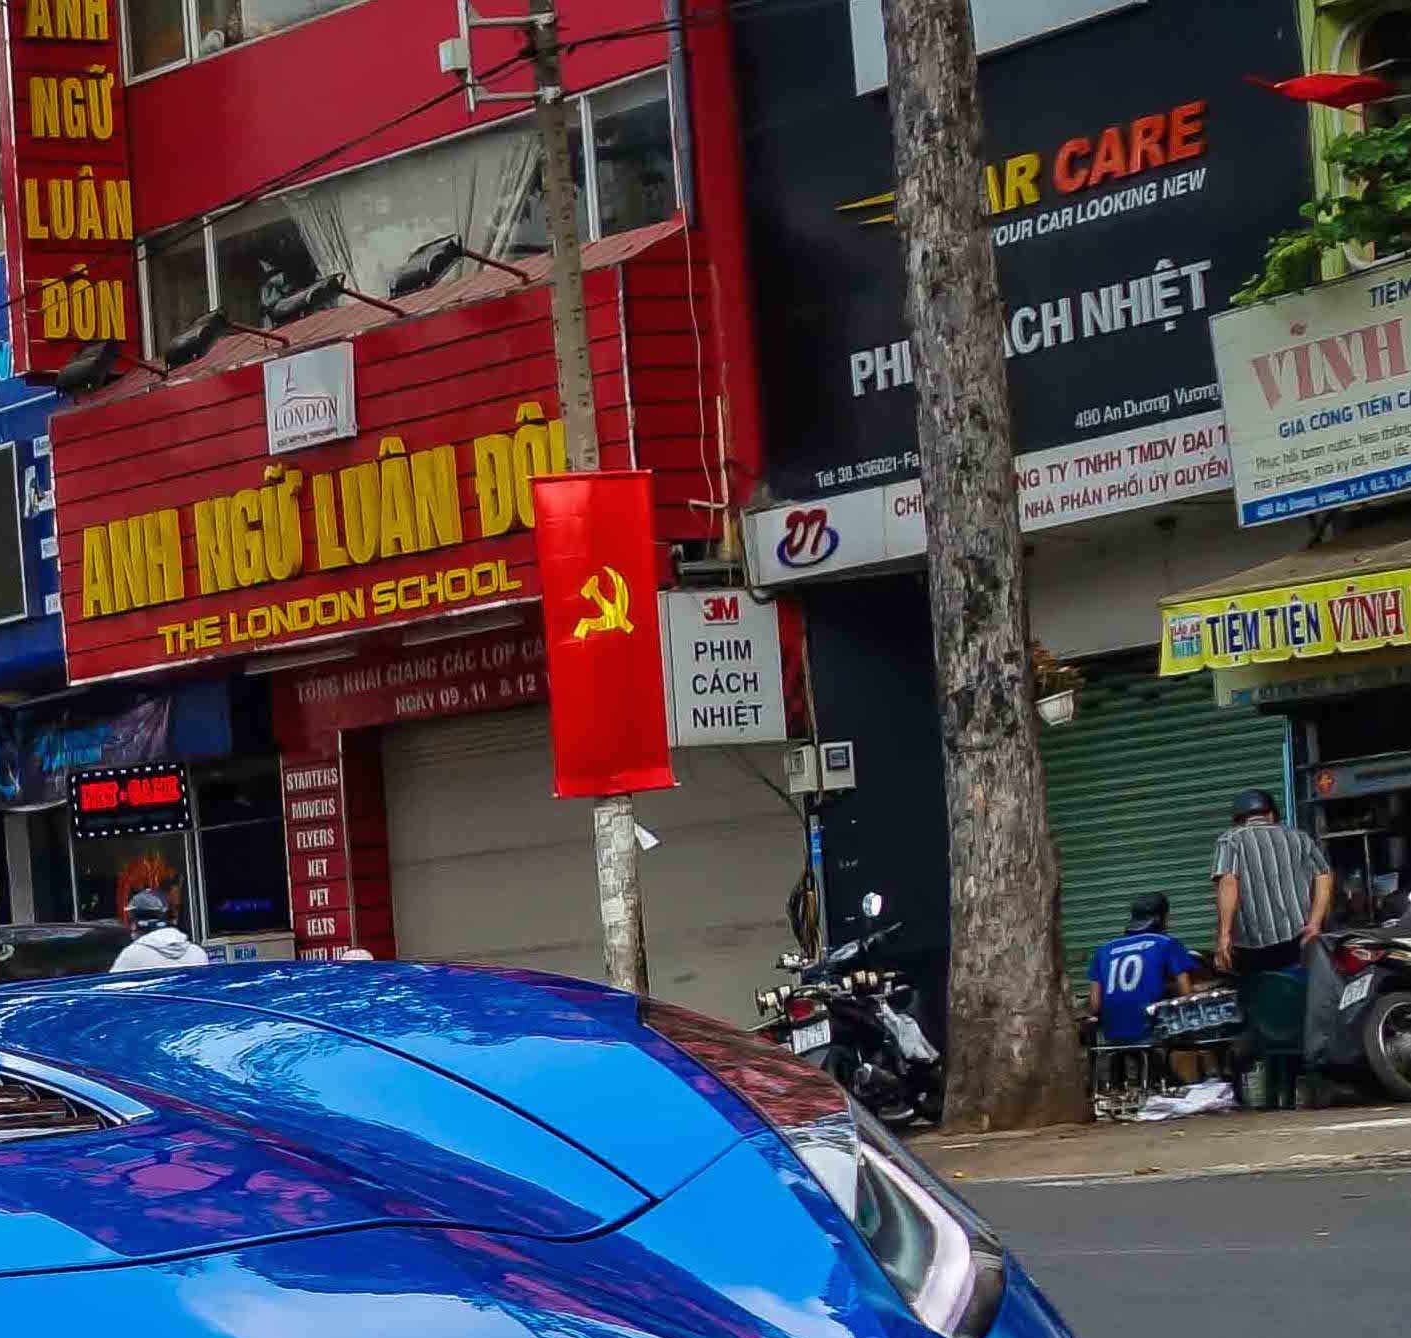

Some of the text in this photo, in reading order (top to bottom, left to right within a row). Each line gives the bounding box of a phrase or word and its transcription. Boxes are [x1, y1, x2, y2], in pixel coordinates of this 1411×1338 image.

[30, 64, 114, 139] NGỮ
[1053, 101, 1207, 194] CARE
[24, 165, 133, 240] LUÂN
[992, 168, 1208, 247] OUR CAR LOOKING NEW
[849, 259, 1212, 397] PHI CH NHIỆT
[274, 395, 338, 431] LONDON
[1104, 405, 1122, 423] An
[1279, 421, 1306, 439] GIA
[1046, 462, 1069, 484] TY
[1074, 449, 1122, 478] TNHH
[1128, 438, 1177, 464] TMDV
[82, 508, 184, 620] ANH
[194, 464, 304, 595] NGỮ
[312, 435, 463, 570] LUÂN
[158, 558, 523, 656] THE LONDON SCHOOL
[703, 596, 740, 622] 3M
[1205, 601, 1261, 662] TIỆM
[1264, 593, 1322, 654] TIỆN
[693, 639, 752, 662] PHIM
[517, 674, 536, 694] 12
[691, 668, 760, 695] CÁCH
[692, 700, 763, 733] NHIỆT
[286, 768, 338, 791] STARTERS
[291, 798, 335, 819] MOVERS
[296, 829, 334, 850] FLYERS
[307, 858, 328, 877] KET
[309, 887, 329, 907] PET
[307, 917, 335, 937] IELTS
[1106, 954, 1143, 994] 10
